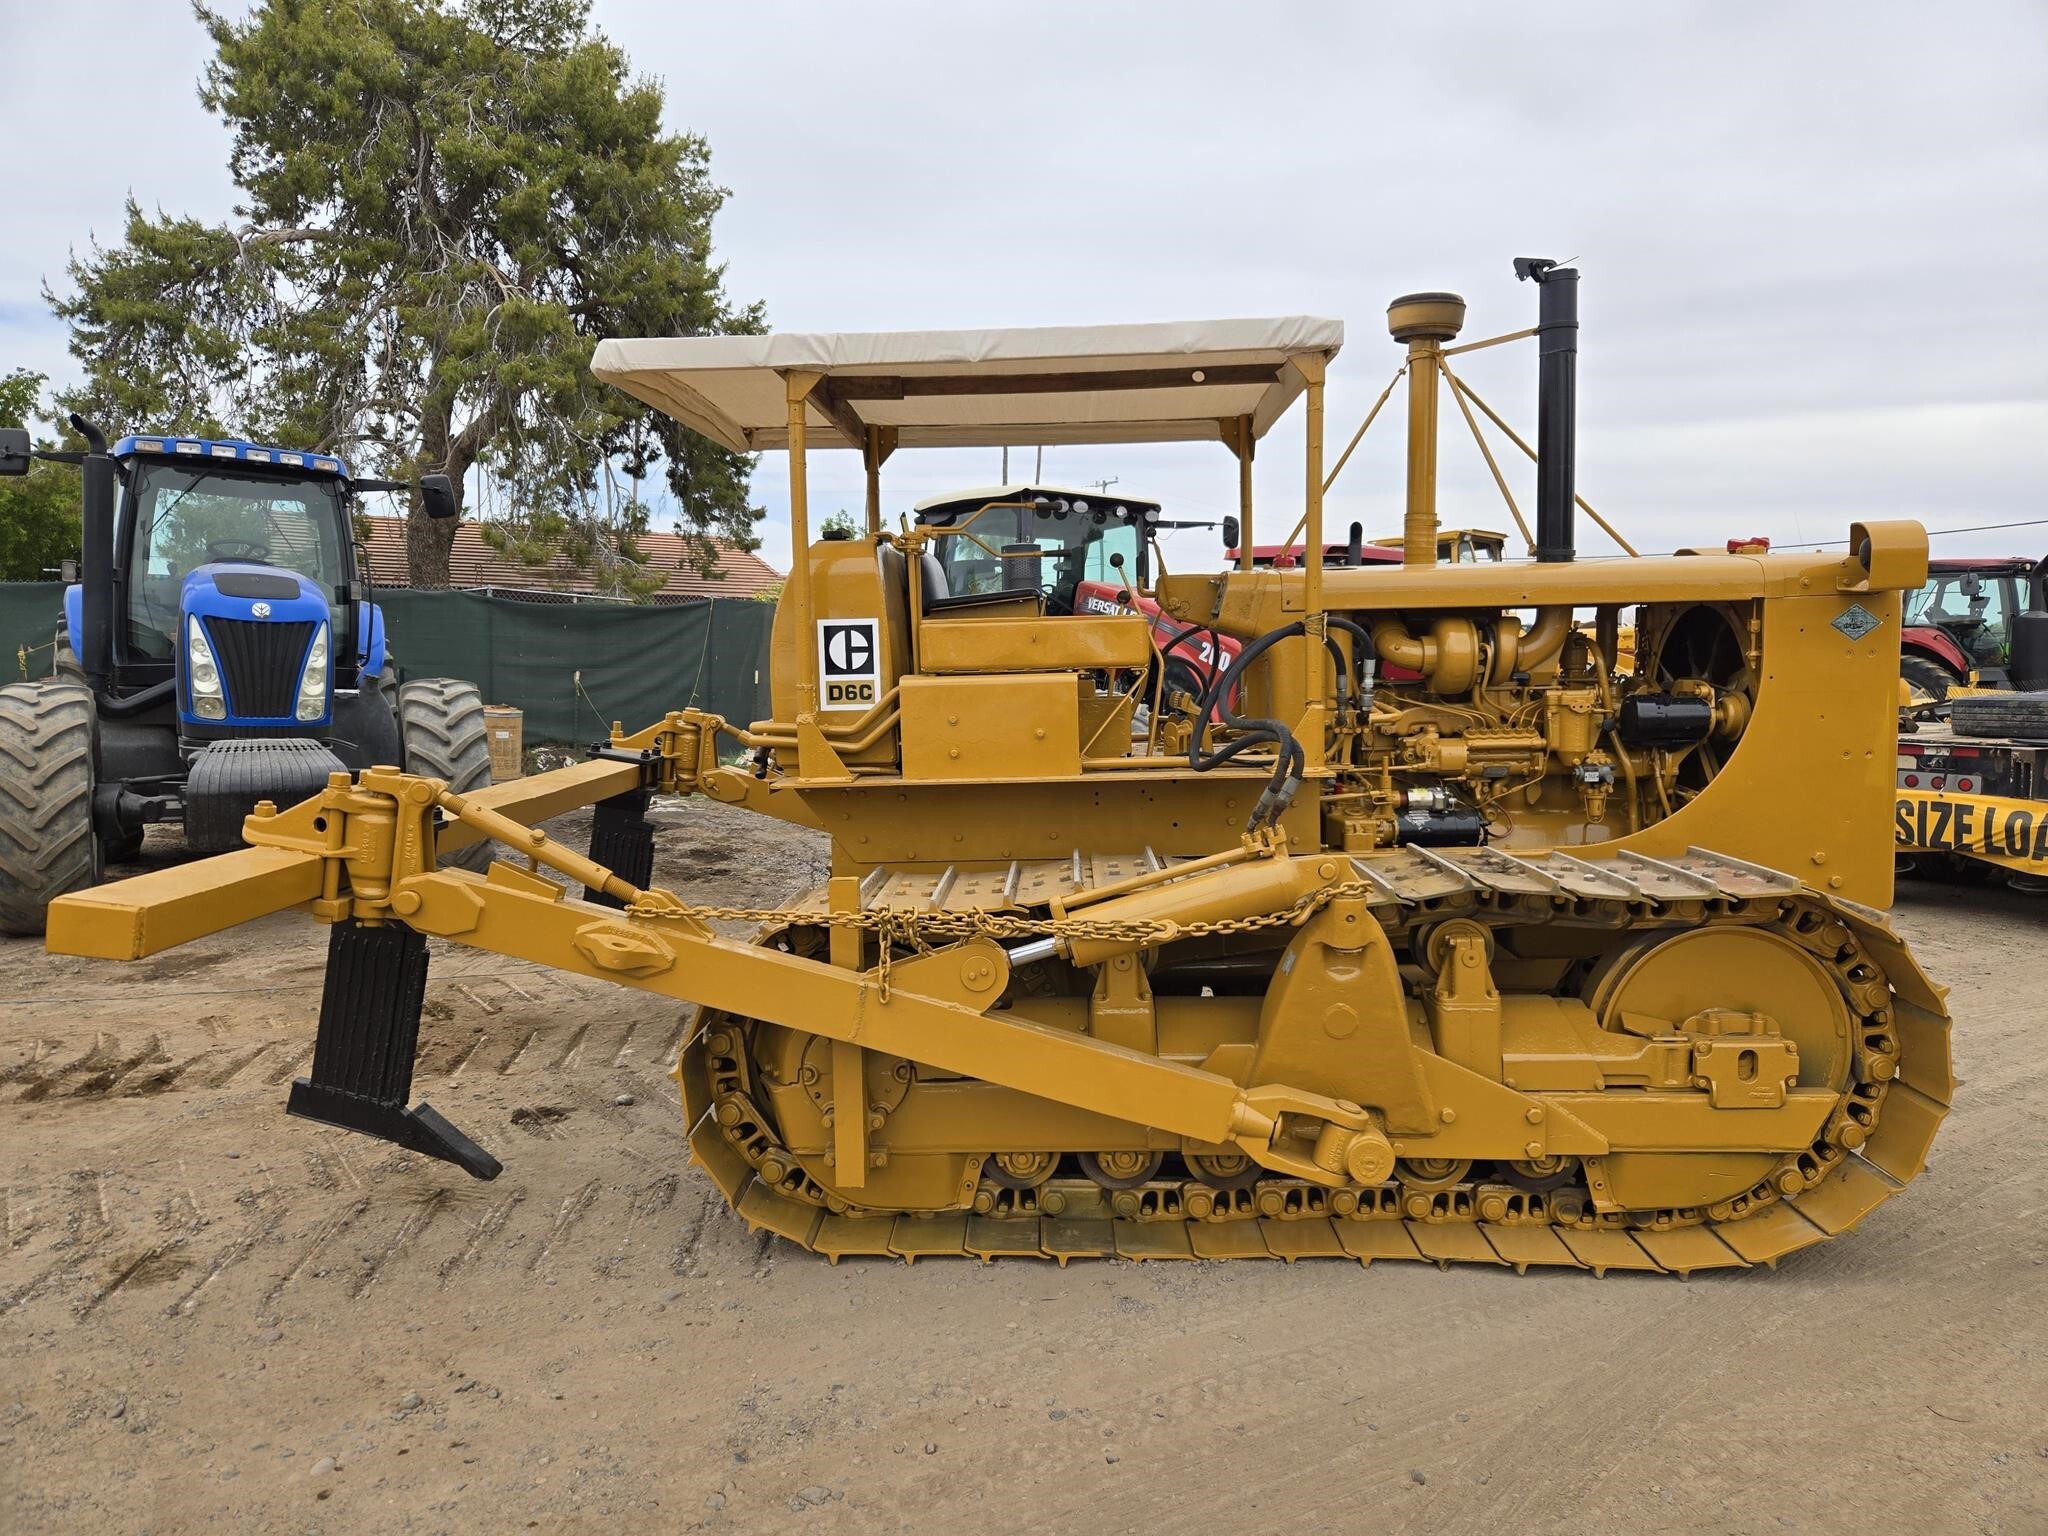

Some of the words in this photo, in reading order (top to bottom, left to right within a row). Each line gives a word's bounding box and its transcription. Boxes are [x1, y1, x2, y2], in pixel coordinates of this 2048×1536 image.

[1088, 597, 1139, 616] VERSATL
[829, 684, 873, 701] D6C
[1895, 800, 1975, 853] SIZE
